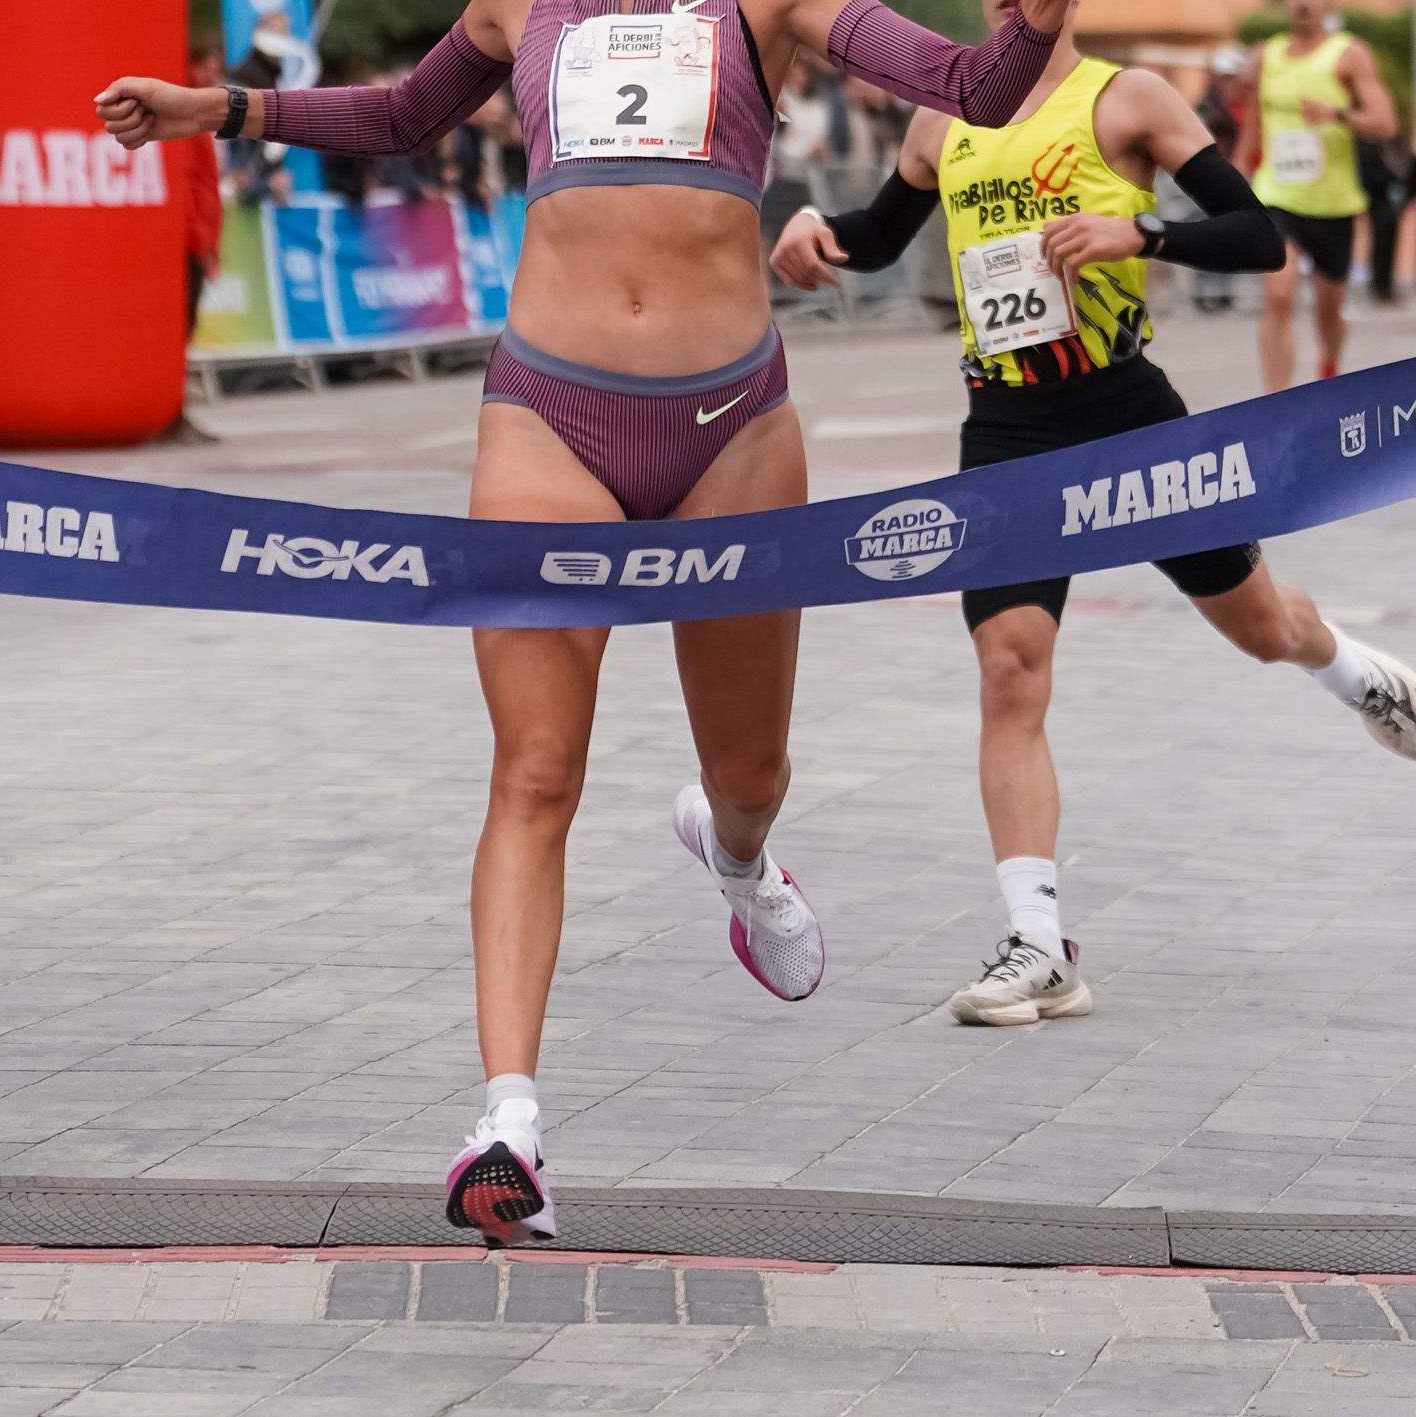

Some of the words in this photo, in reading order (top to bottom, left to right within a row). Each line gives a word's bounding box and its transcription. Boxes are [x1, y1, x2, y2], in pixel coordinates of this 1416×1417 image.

[608, 42, 662, 52] AFICIONES
[615, 83, 648, 125] 2
[981, 288, 1047, 332] 226
[220, 529, 430, 587] HOKA
[619, 544, 747, 586] BM
[1061, 441, 1258, 537] MARCA
[872, 509, 944, 535] RADIO
[859, 527, 954, 559] MARCA
